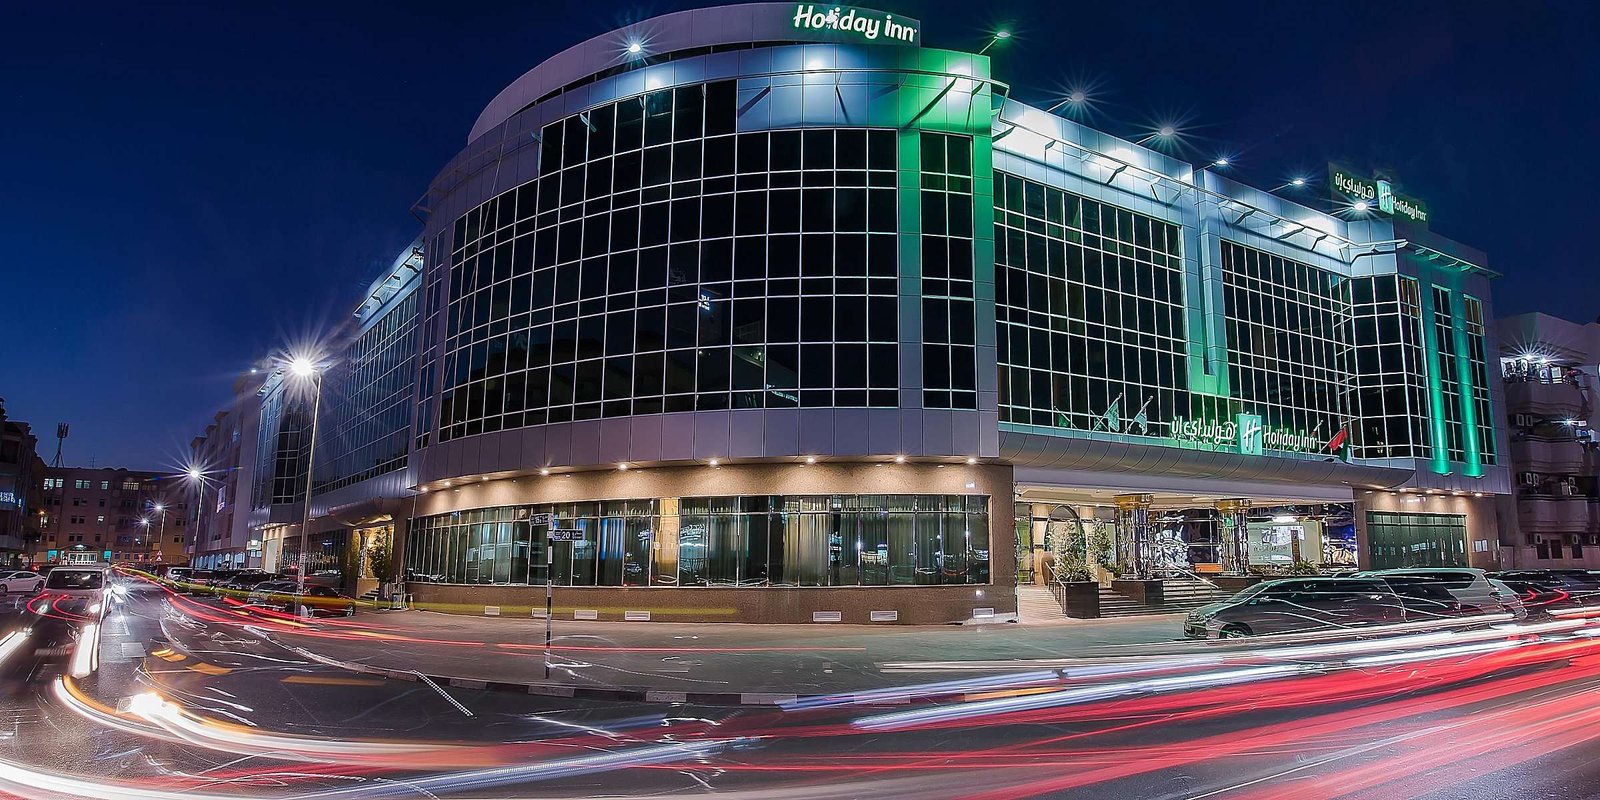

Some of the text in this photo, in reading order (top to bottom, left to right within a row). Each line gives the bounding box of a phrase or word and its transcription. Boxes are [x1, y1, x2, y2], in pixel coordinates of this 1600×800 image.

[1391, 195, 1416, 220] Holiday
[1263, 425, 1316, 451] Holiday Inn
[561, 531, 571, 539] 20
